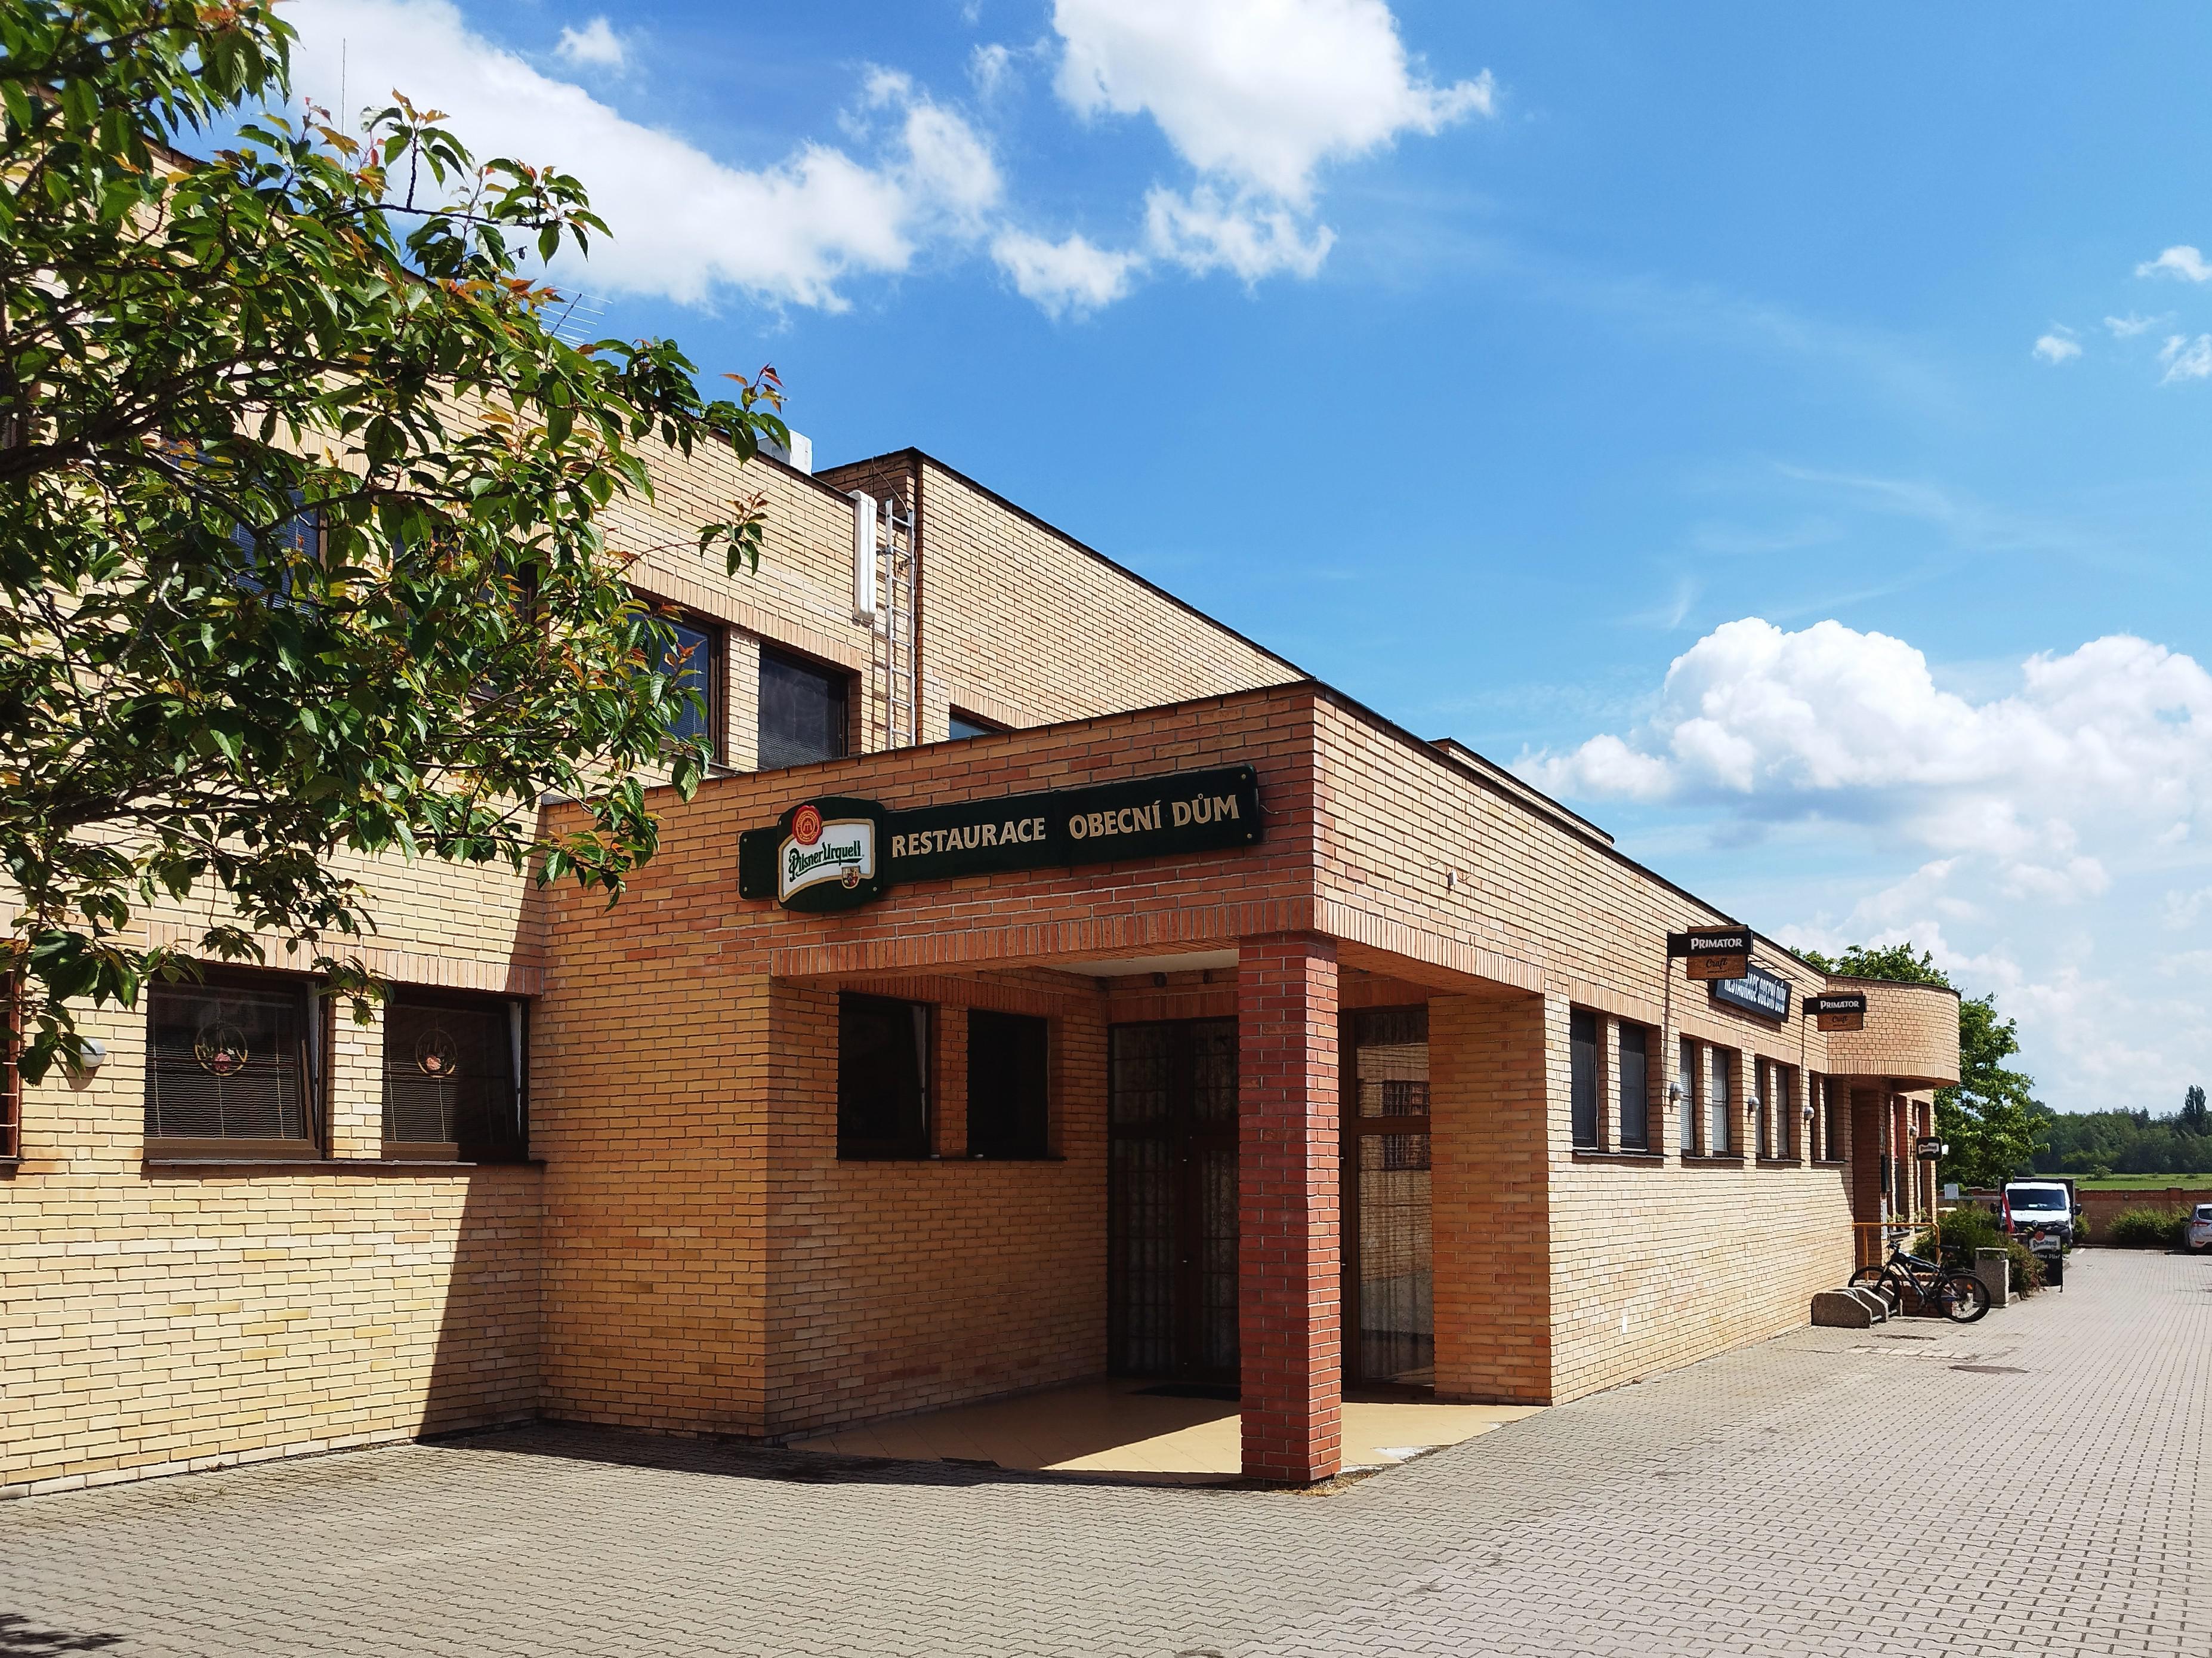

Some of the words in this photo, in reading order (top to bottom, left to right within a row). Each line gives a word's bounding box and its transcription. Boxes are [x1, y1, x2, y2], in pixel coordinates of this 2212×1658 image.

[892, 817, 1045, 858] RESTAURACE
[1069, 800, 1162, 839] OBECNÍ
[1171, 793, 1240, 827] DŮM
[788, 848, 823, 882] Pilsner
[822, 840, 861, 866] Urquell
[1690, 938, 1743, 950] PRIMATOR
[1706, 957, 1728, 969] Craft
[1820, 1000, 1860, 1009] PRIMATOR
